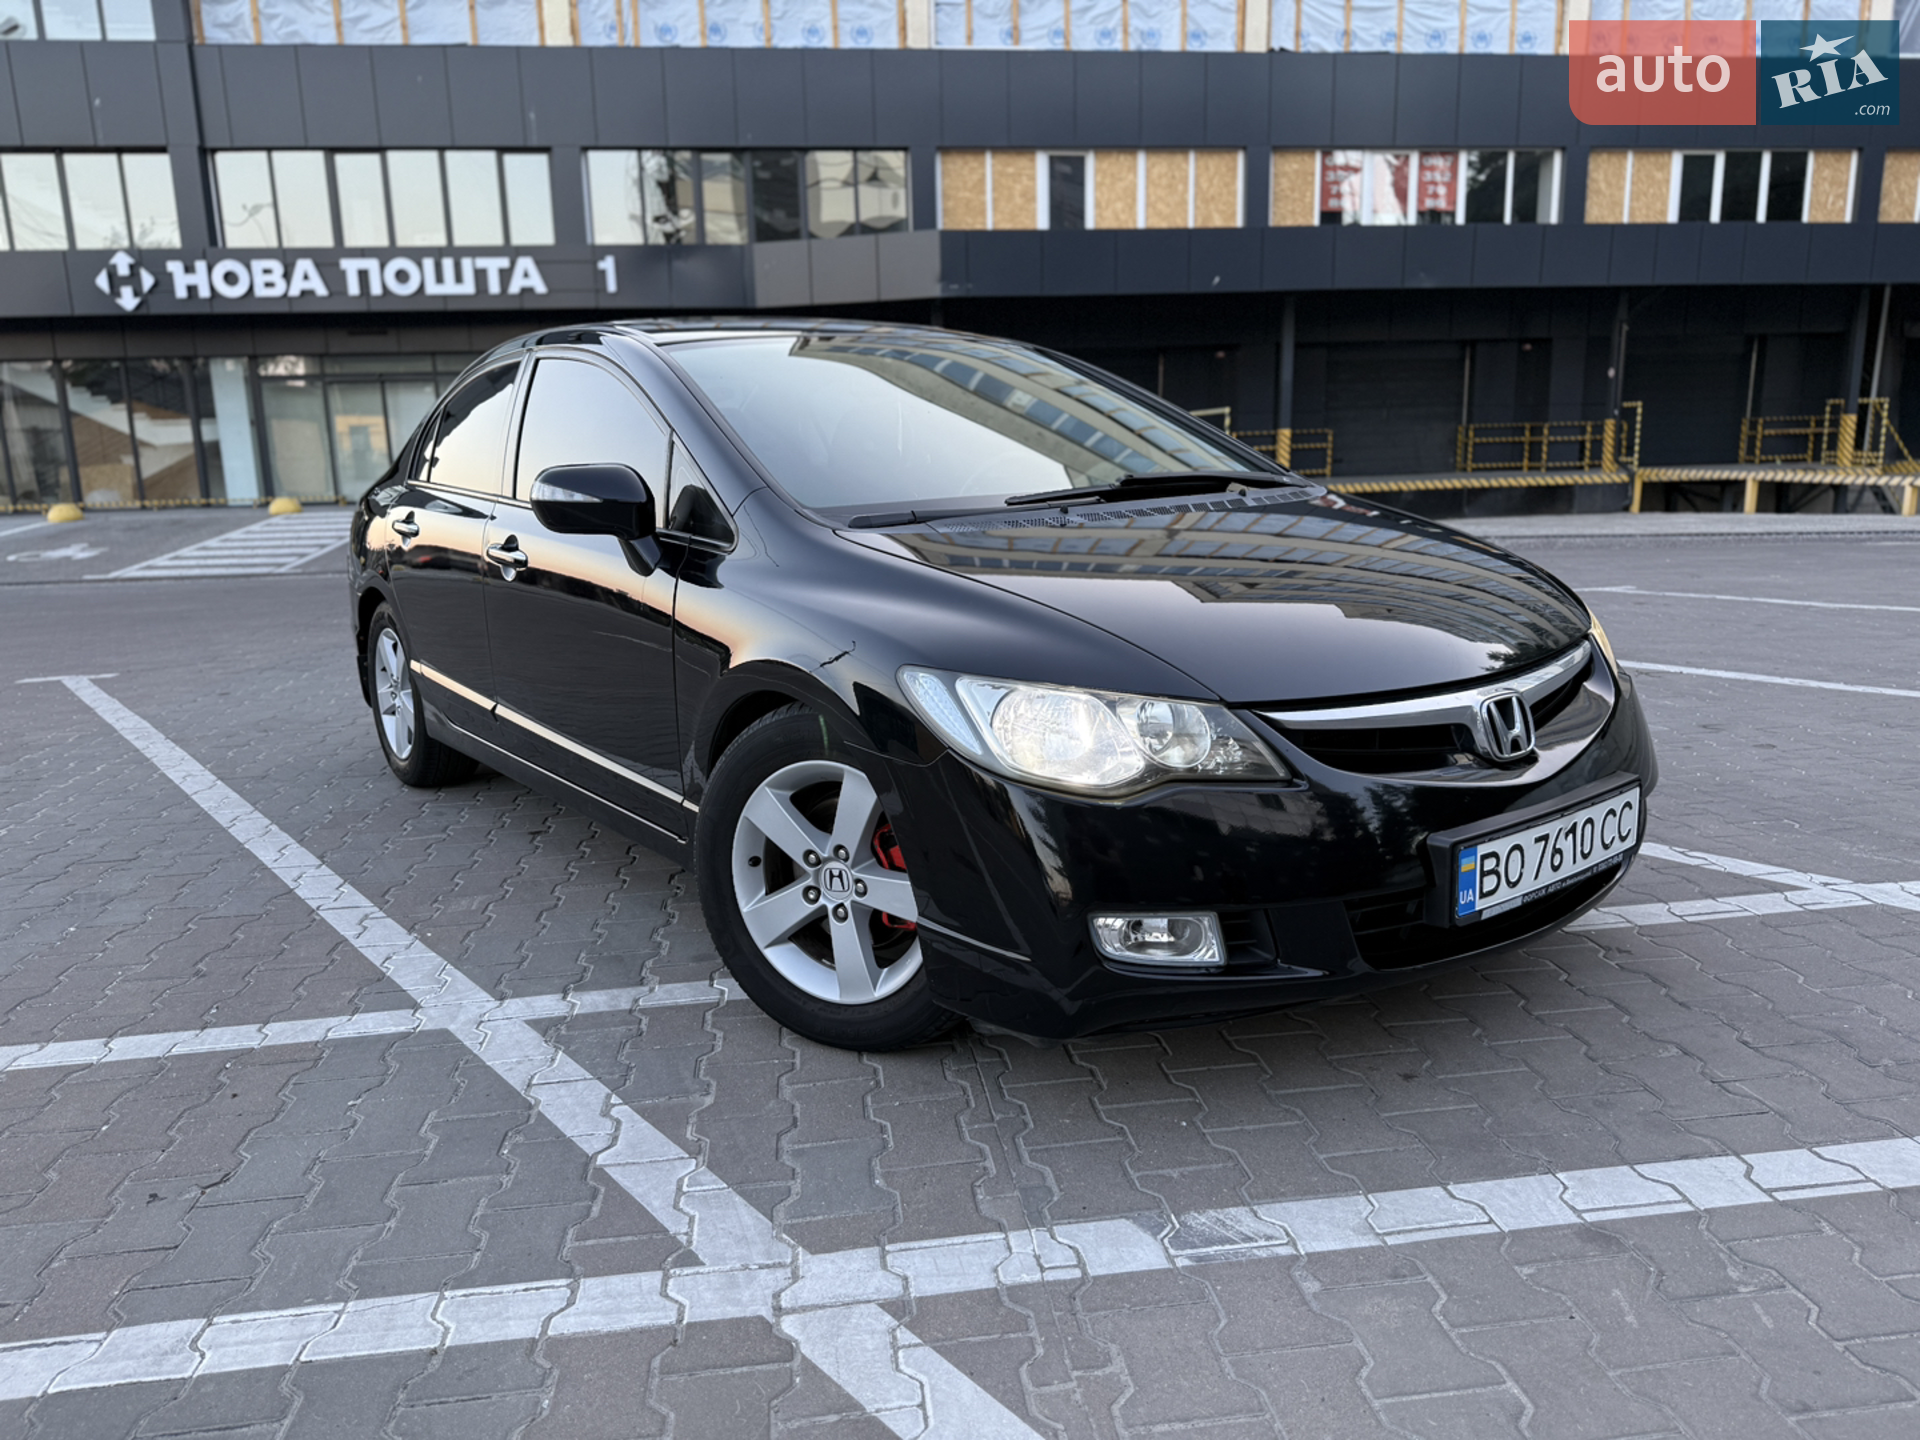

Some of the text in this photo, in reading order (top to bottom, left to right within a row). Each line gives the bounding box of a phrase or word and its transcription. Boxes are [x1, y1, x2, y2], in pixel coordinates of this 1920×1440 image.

[166, 254, 619, 300] НОВА ПОШТА 1
[1478, 843, 1525, 901] BO
[1532, 816, 1595, 882] 7610
[1600, 800, 1633, 851] CC
[1459, 888, 1475, 905] UA
